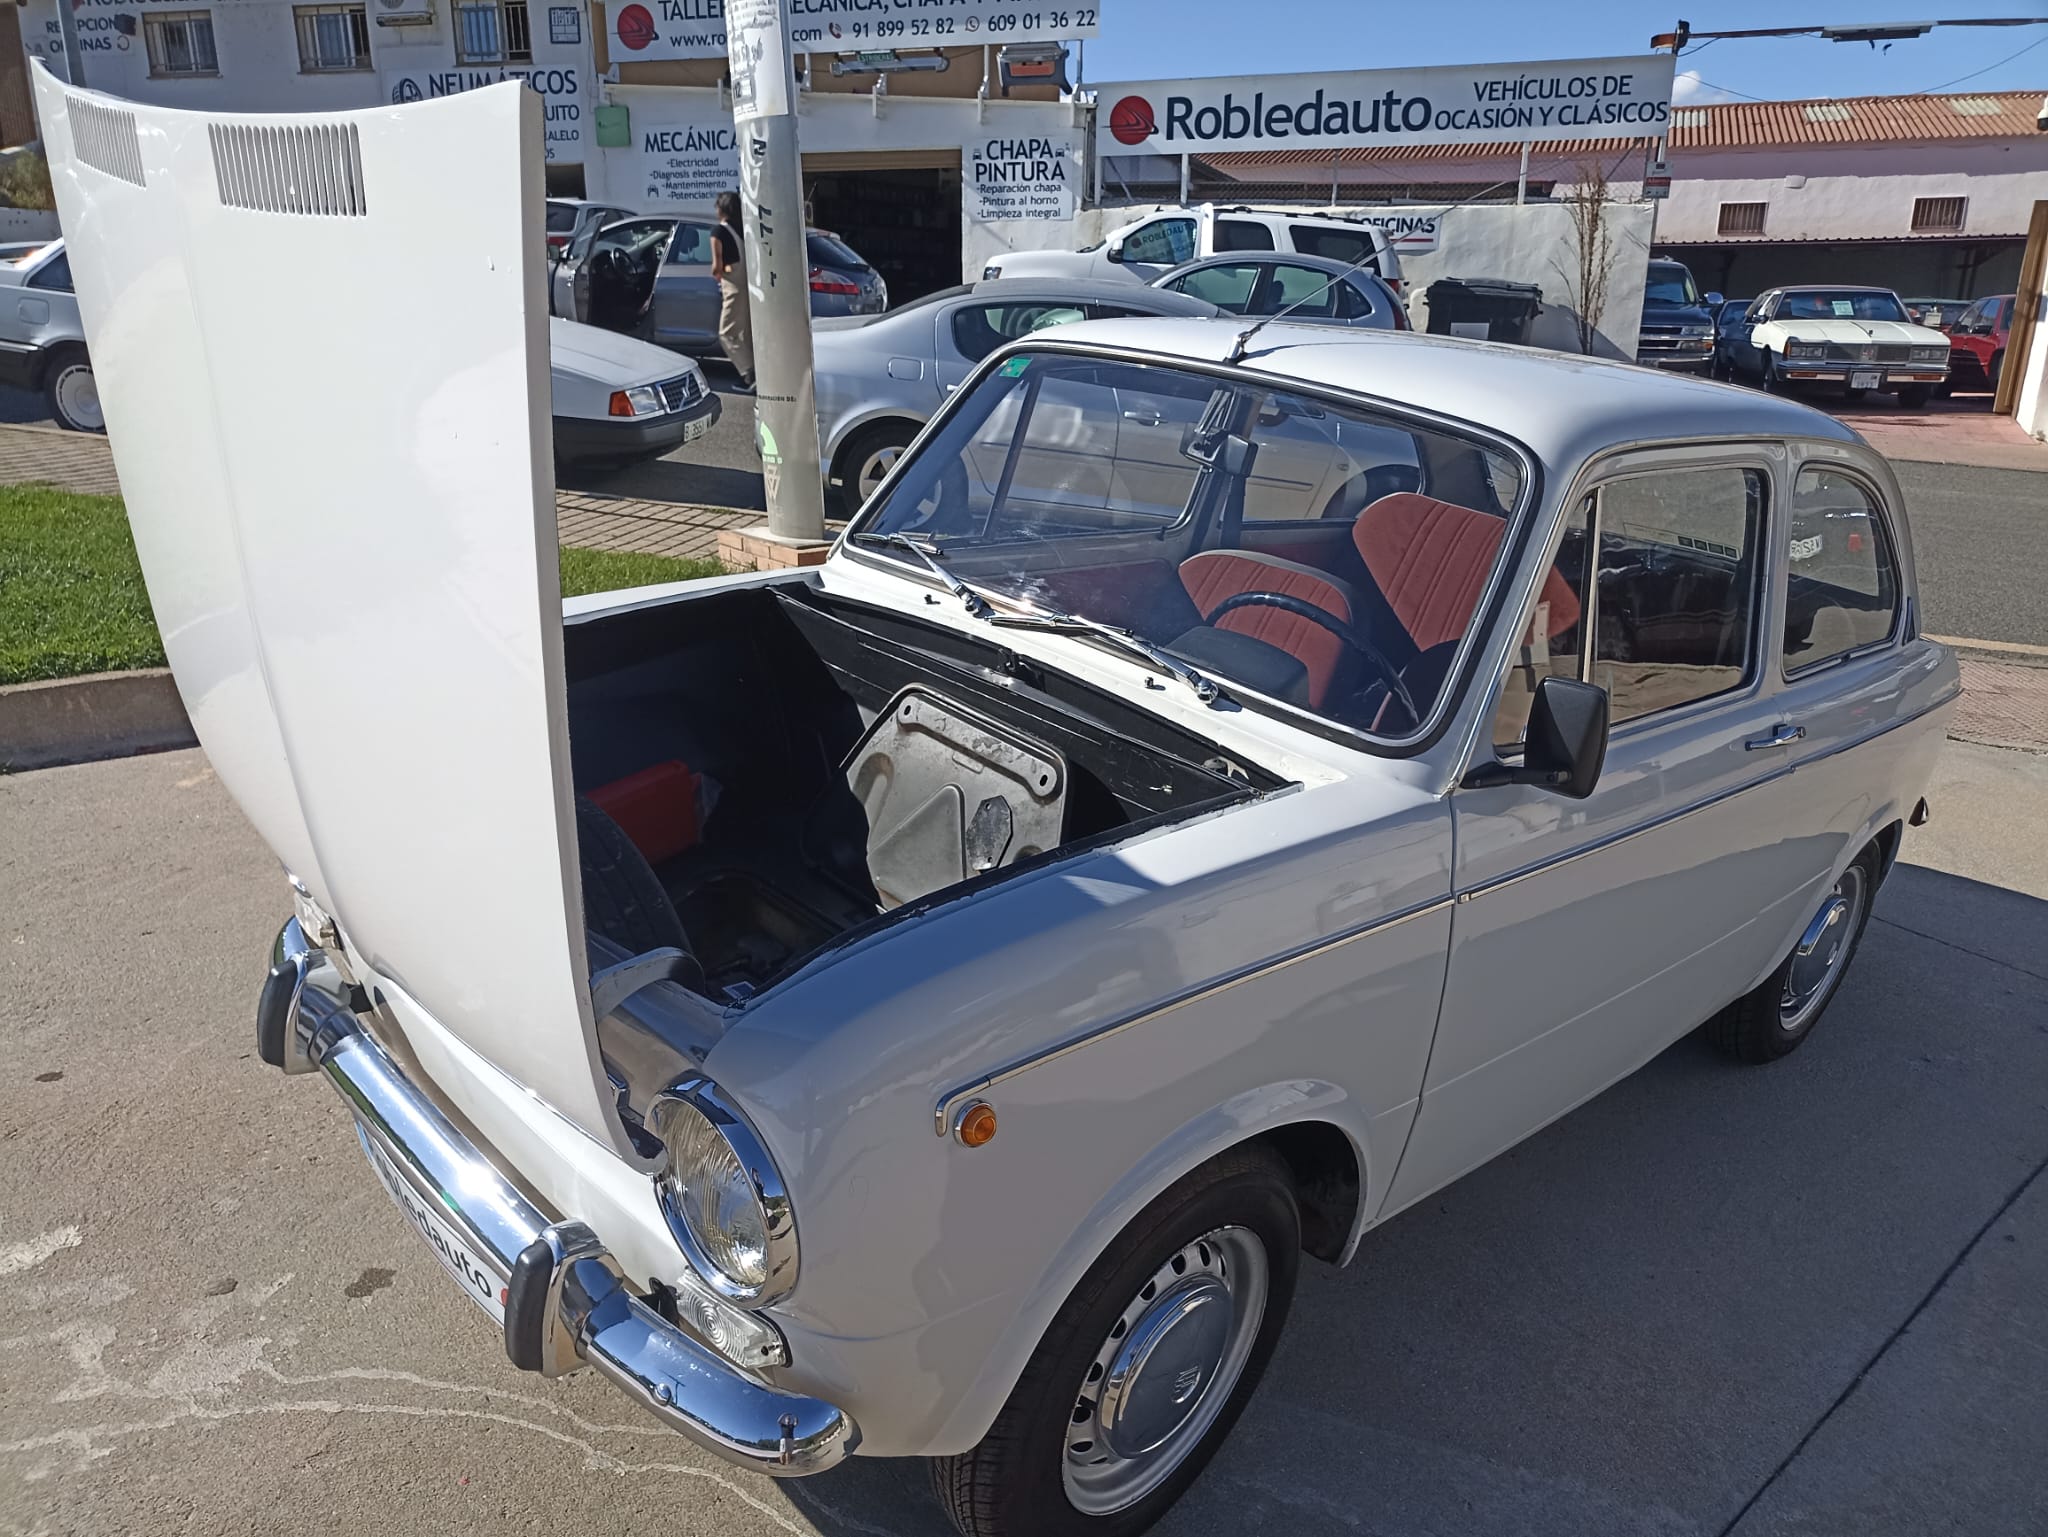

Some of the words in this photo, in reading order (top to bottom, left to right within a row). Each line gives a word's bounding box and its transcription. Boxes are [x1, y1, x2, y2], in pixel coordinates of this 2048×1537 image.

[46, 17, 115, 33] REPCION
[852, 22, 869, 38] 91
[877, 20, 904, 37] 899
[911, 19, 930, 35] 52
[936, 17, 955, 33] 82
[988, 14, 1017, 32] 609
[1023, 13, 1041, 29] 01
[1050, 11, 1069, 28] 36
[1076, 9, 1096, 26] 22
[50, 36, 112, 53] OINAS
[1474, 74, 1597, 102] VEHÍCULOS
[1602, 75, 1633, 97] DE
[544, 104, 580, 121] UITO
[1165, 89, 1432, 141] Robledauto
[1434, 103, 1533, 131] OCASIÓN
[1539, 107, 1554, 126] Y
[1557, 98, 1668, 126] CLÁSICOS
[546, 129, 580, 141] ALELO
[986, 138, 1054, 160] CHAPA
[692, 168, 739, 178] electrónica
[975, 160, 1066, 183] PINTURA
[1034, 182, 1062, 194] chapa
[1018, 196, 1028, 206] al
[1030, 195, 1060, 205] horno
[1025, 207, 1061, 219] integral
[374, 1153, 493, 1298] bledauto
